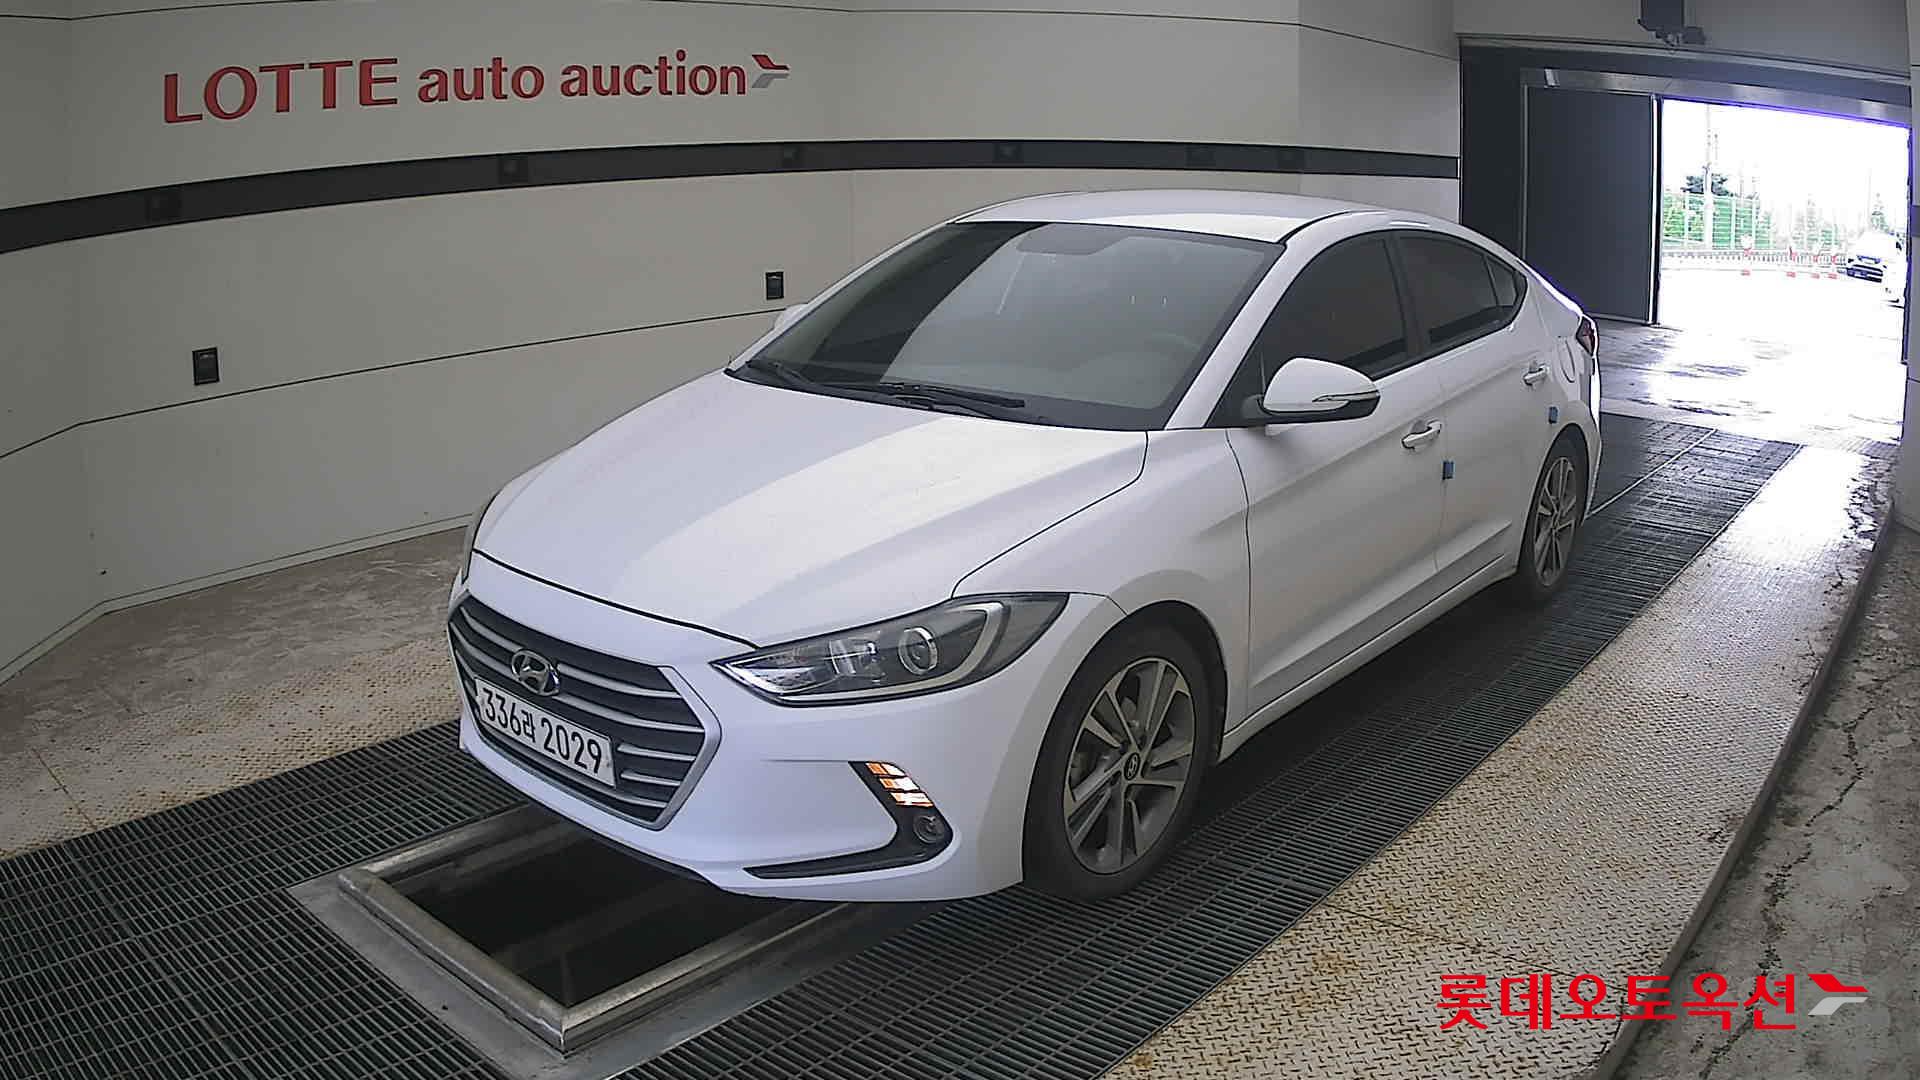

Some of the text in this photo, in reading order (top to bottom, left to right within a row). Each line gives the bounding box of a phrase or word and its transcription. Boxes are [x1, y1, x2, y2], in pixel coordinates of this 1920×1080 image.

[163, 49, 747, 124] LOTTE auto auction
[482, 688, 602, 774] 336라 2029
